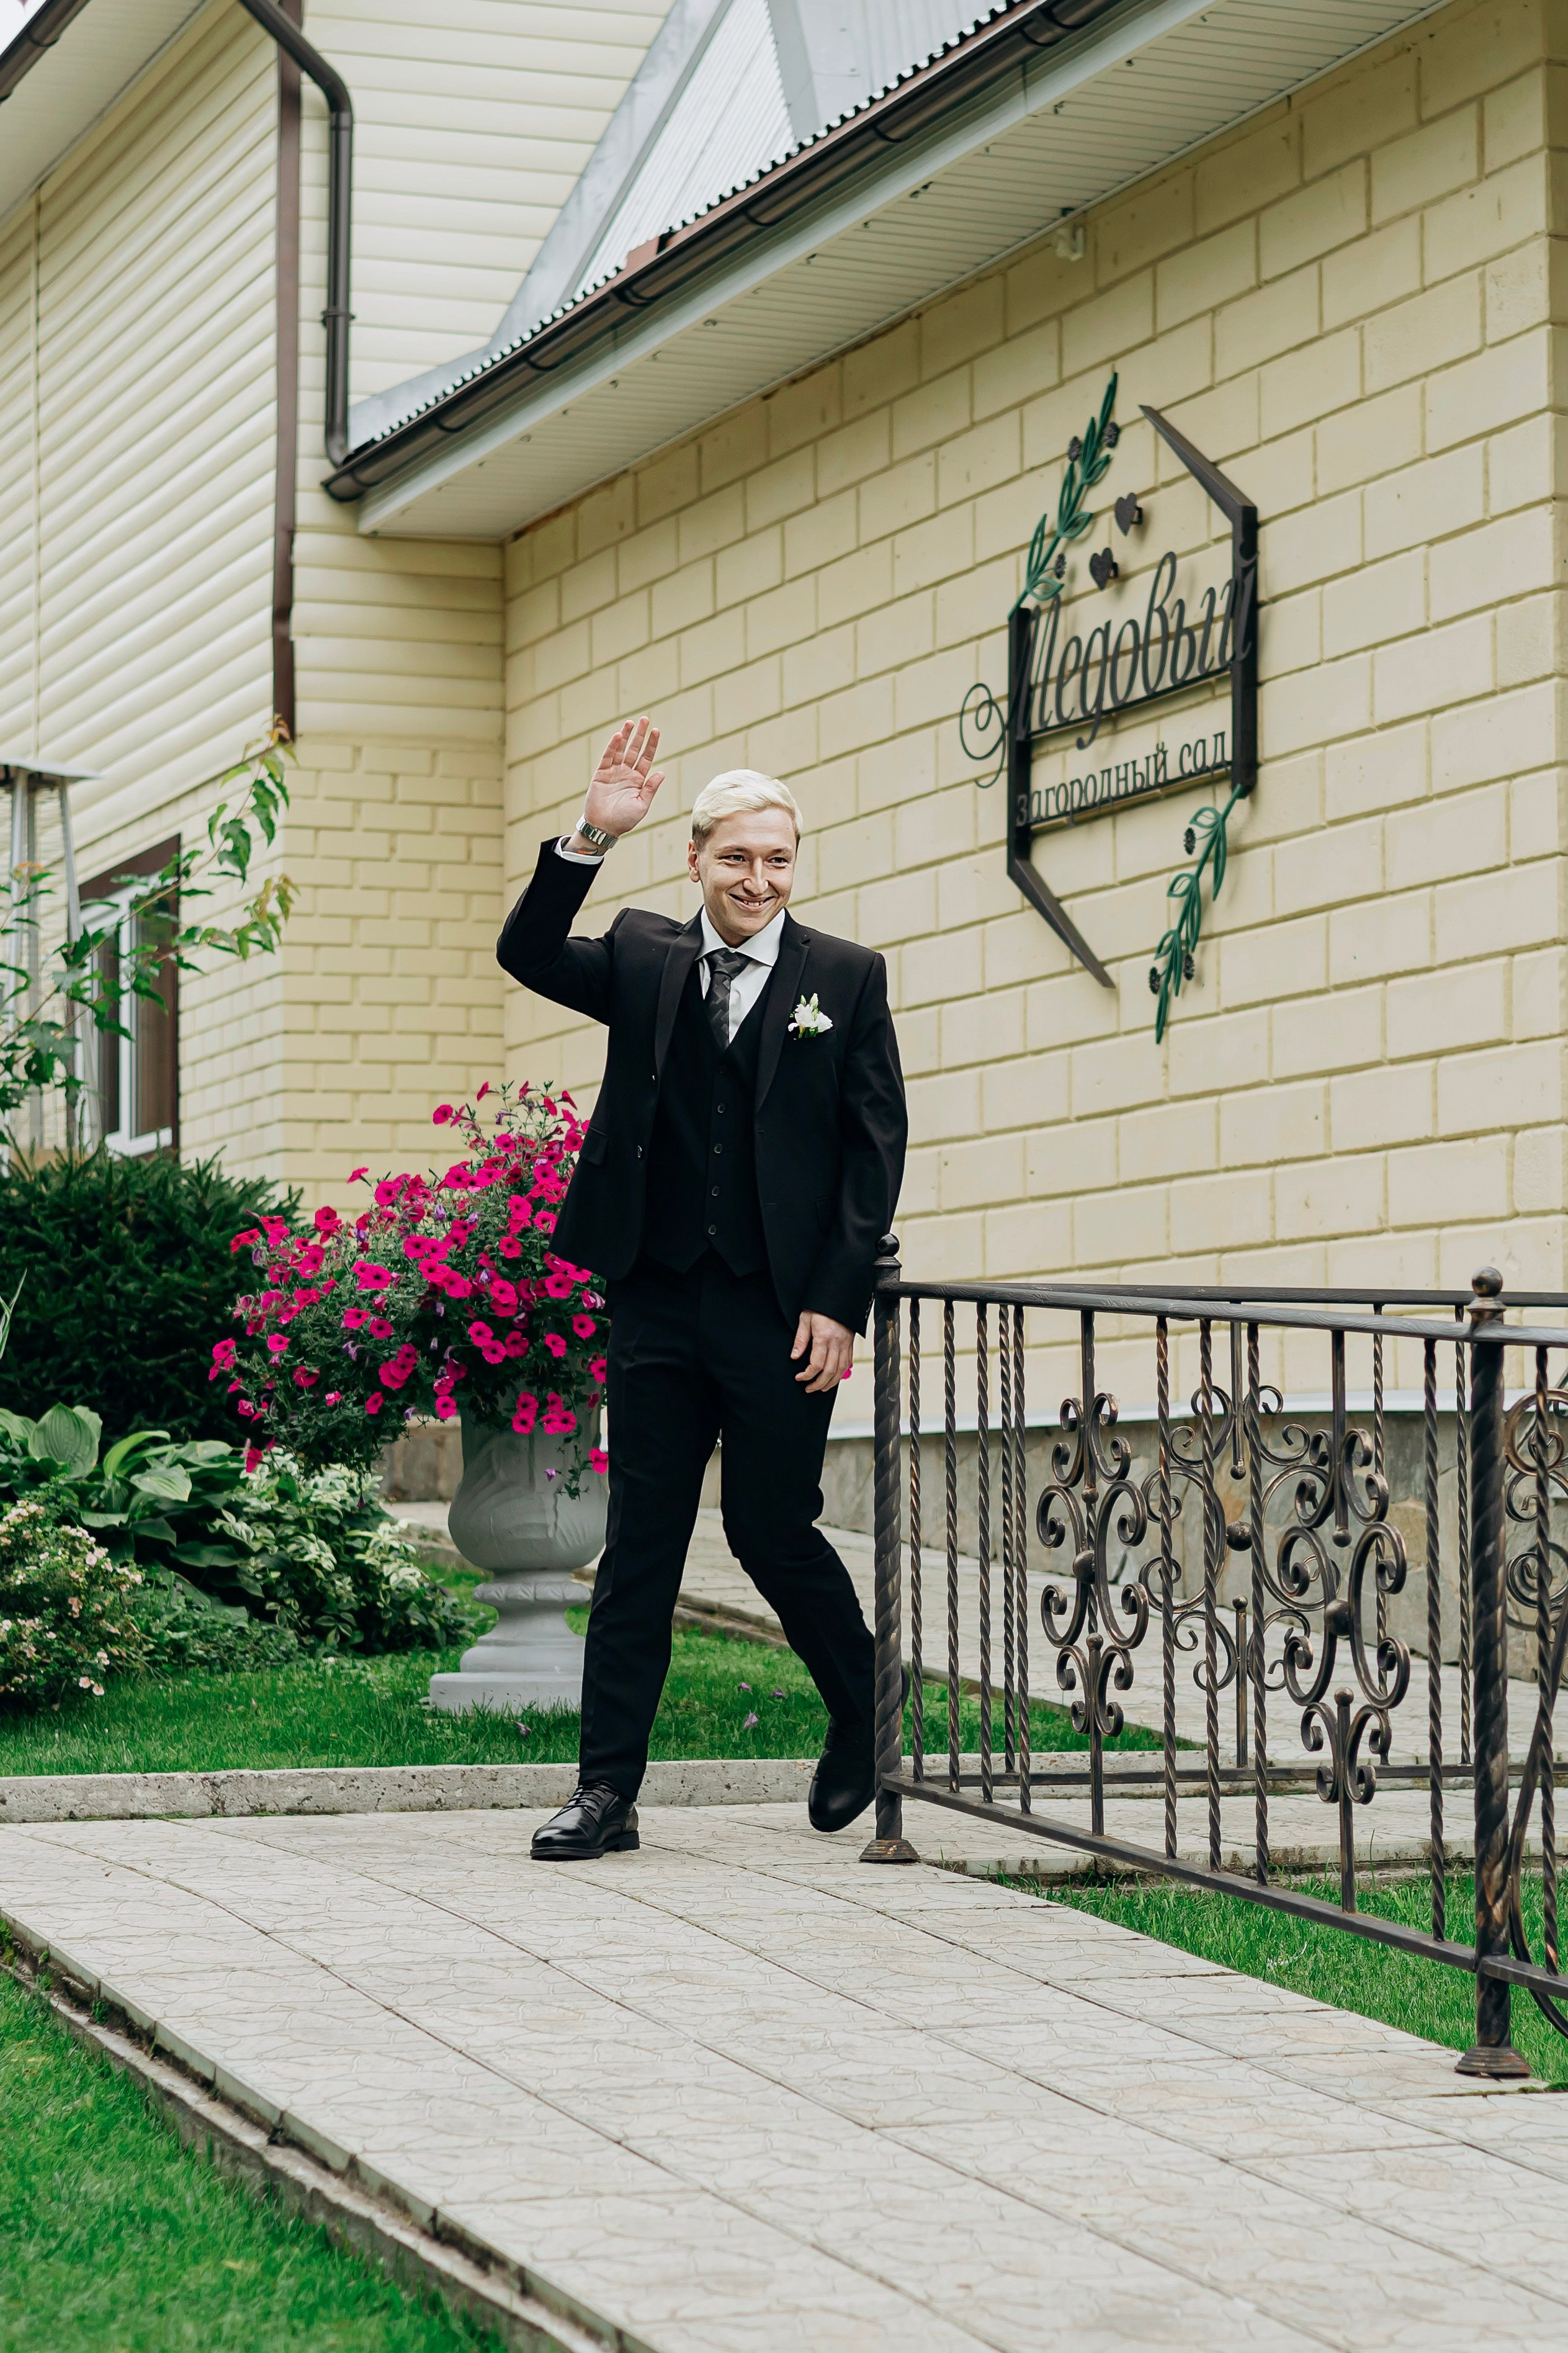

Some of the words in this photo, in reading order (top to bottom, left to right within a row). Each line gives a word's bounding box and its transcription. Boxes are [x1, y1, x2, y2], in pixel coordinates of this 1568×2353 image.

[993, 539, 1260, 751] Медовый
[1016, 741, 1168, 827] загородный
[1179, 731, 1232, 777] сад
